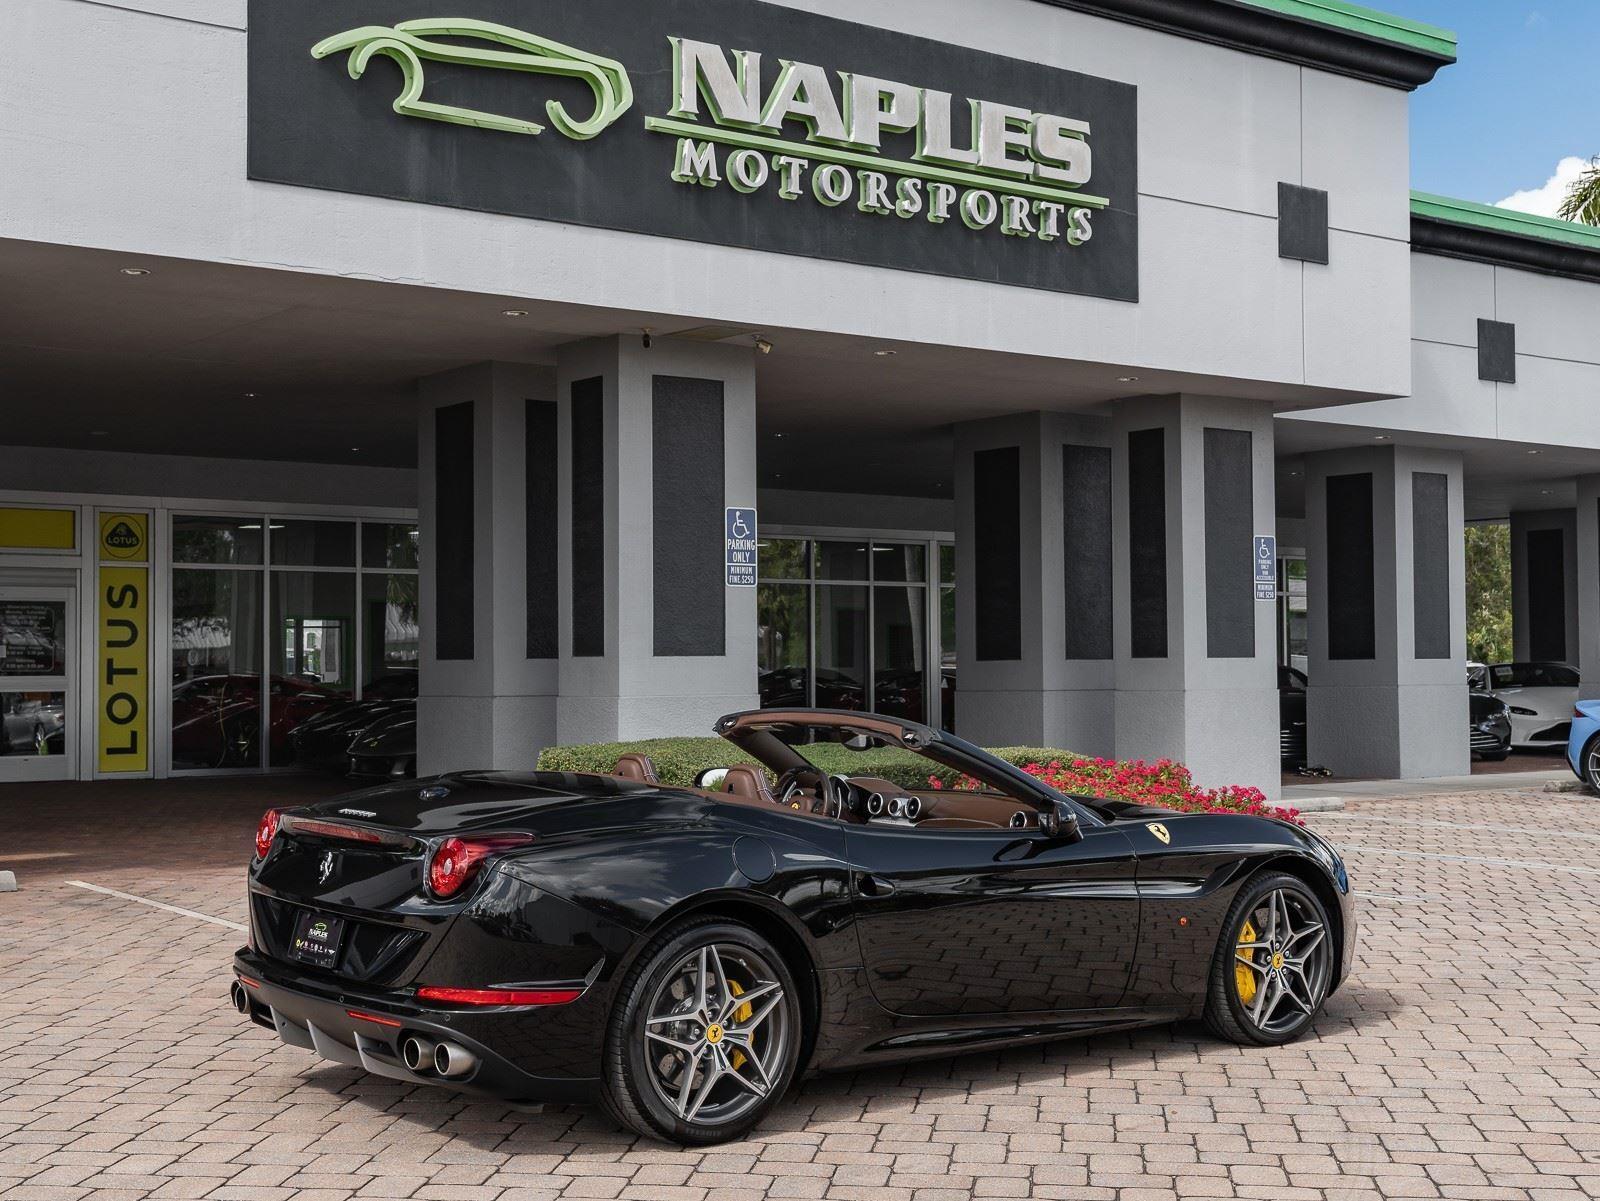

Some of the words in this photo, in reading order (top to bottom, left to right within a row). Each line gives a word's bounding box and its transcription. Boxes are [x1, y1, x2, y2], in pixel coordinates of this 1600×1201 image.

[667, 35, 1092, 189] NAPLES
[671, 137, 1093, 246] MOTORSPORTS
[108, 536, 138, 545] LOTUS
[728, 539, 756, 550] PARKING
[732, 552, 750, 562] ONLY
[729, 575, 741, 584] FINE
[742, 576, 754, 584] $250
[106, 584, 139, 755] LOTUS
